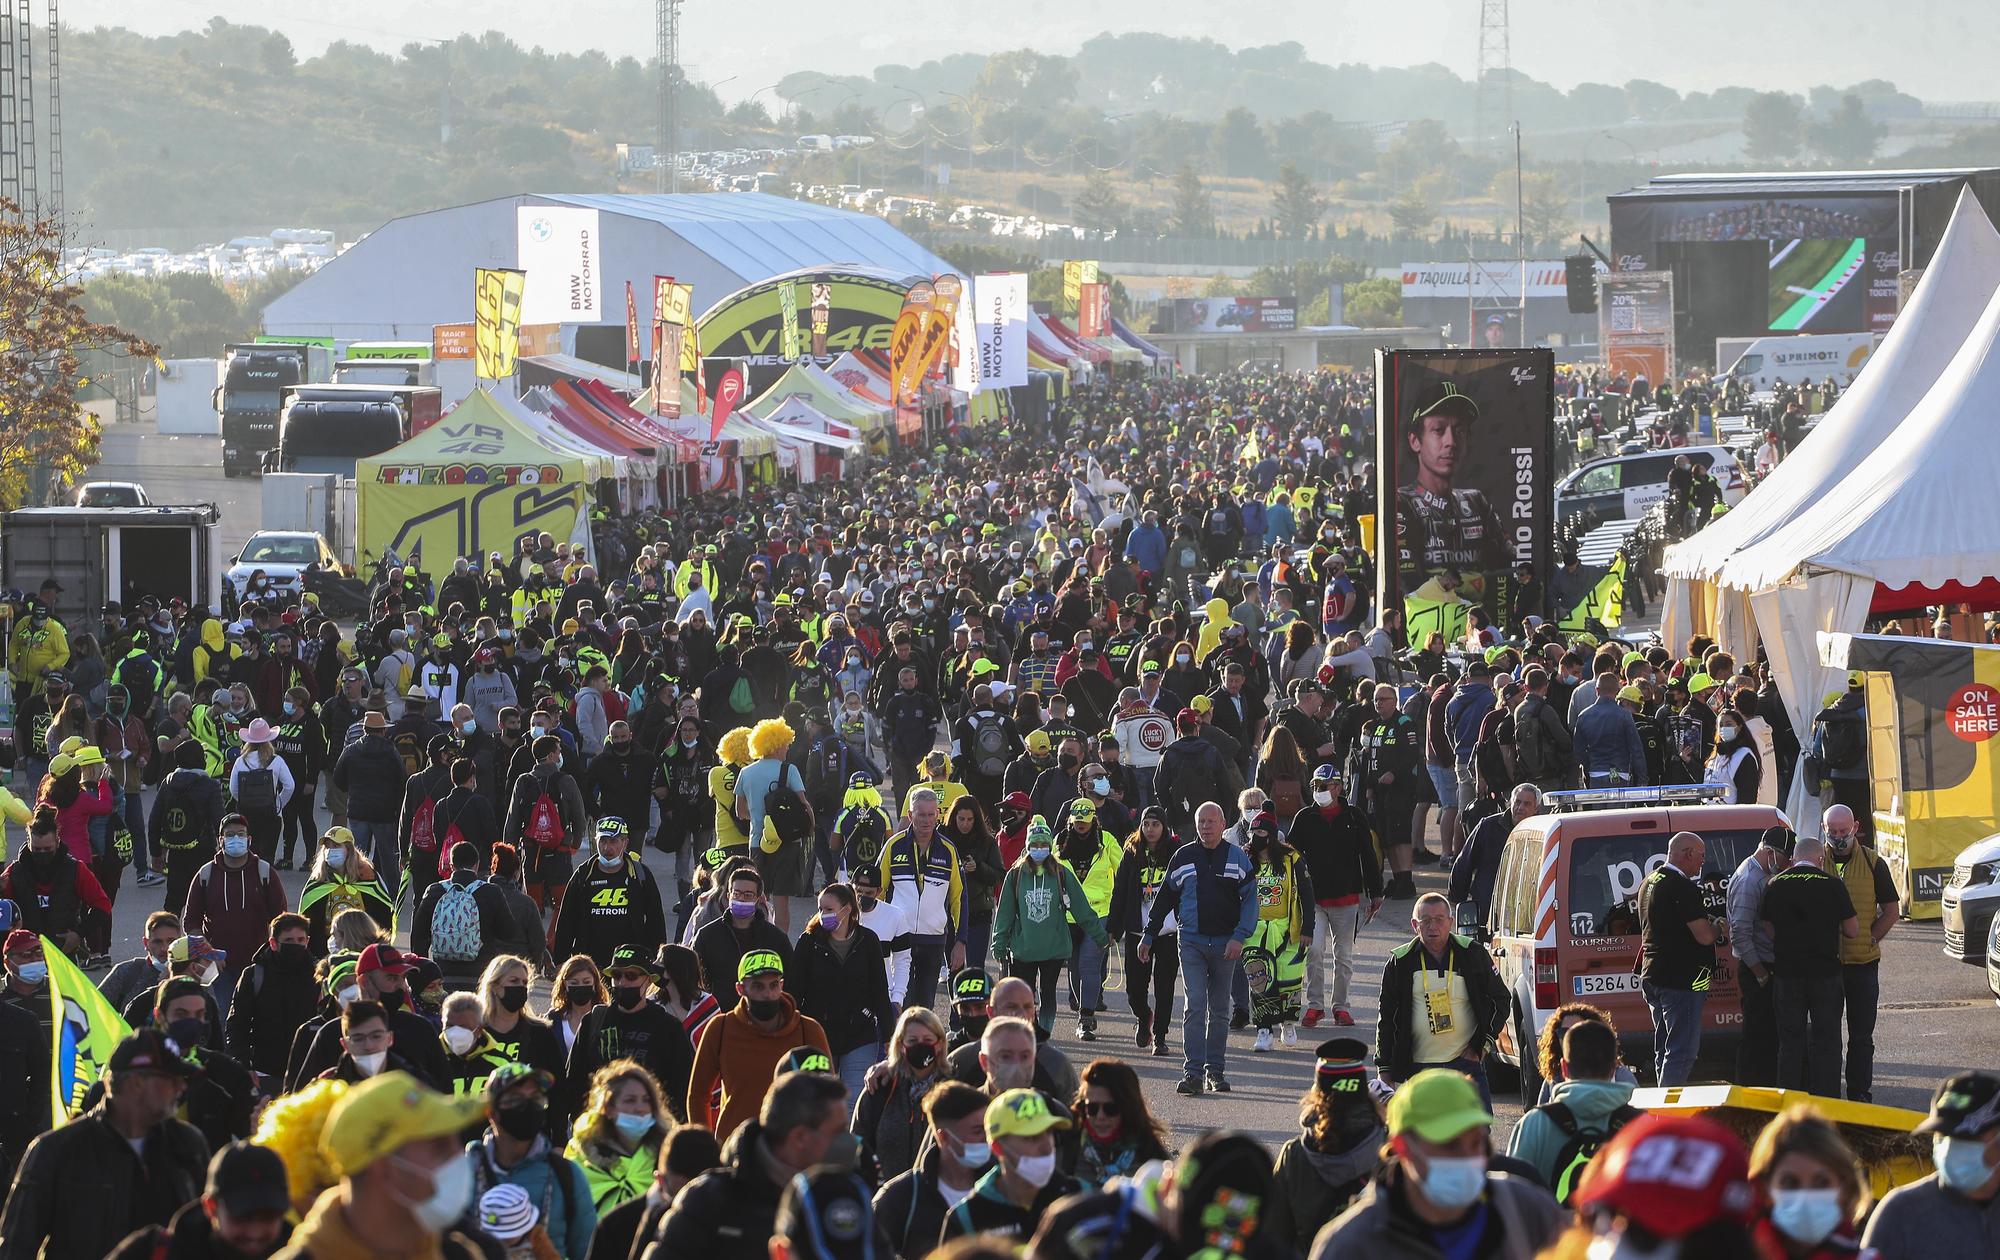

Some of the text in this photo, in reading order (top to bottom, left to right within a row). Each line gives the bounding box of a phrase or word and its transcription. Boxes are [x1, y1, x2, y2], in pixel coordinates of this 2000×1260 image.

[581, 230, 592, 310] MOTORRAD
[1419, 272, 1470, 287] TAQUILLA
[1874, 280, 1898, 288] RACIN
[572, 275, 580, 310] BMW
[1869, 288, 1898, 297] TOGETH
[1612, 296, 1635, 305] 20%
[1872, 313, 1896, 322] MOTU
[993, 296, 1002, 378] MOTORRAD
[441, 424, 504, 440] VR
[438, 442, 505, 454] 46
[380, 464, 562, 484] THE DOCTOR
[1511, 448, 1534, 518] Rossi
[1633, 496, 1666, 505] GUARDIA
[1498, 576, 1507, 605] VALE
[1110, 645, 1132, 656] 46
[1964, 691, 1988, 703] ON
[1956, 704, 1996, 718] SALE
[1954, 719, 1998, 732] HERE
[600, 820, 619, 829] 46
[894, 854, 908, 862] 46
[591, 888, 628, 906] 46
[1572, 920, 1594, 934] 112
[1569, 937, 1625, 946] TOURNEO
[614, 950, 635, 958] 46
[744, 954, 780, 971] 46
[958, 979, 984, 994] 46
[1584, 975, 1639, 992] 5264 G
[1716, 1014, 1744, 1024] UPC
[800, 1054, 830, 1070] 46
[1331, 1078, 1360, 1092] 46
[1625, 1136, 1724, 1190] 93
